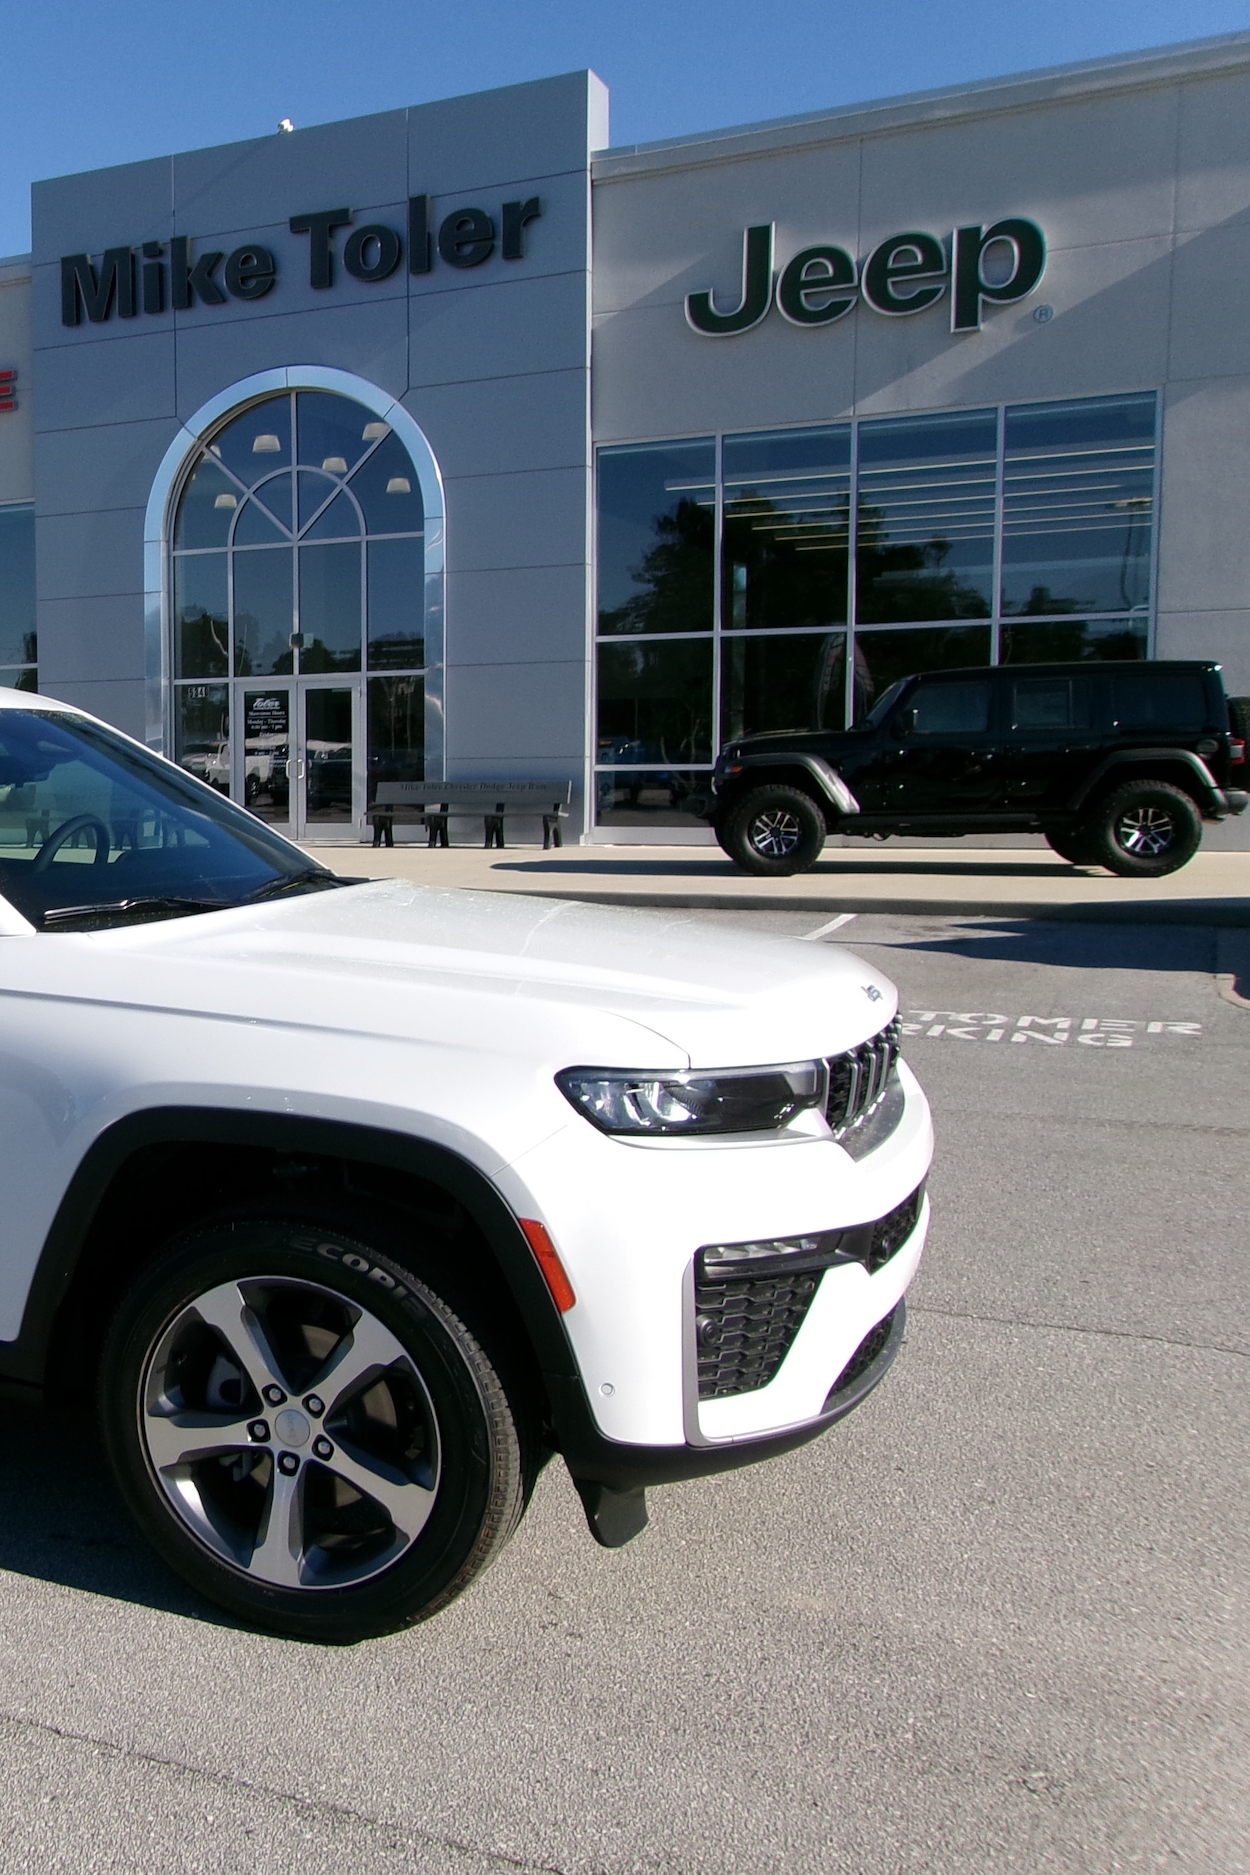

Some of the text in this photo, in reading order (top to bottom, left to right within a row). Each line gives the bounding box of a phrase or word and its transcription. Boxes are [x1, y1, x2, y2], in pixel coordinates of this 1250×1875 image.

[60, 193, 542, 327] Mike Toler
[684, 215, 1049, 338] Jeep
[900, 1023, 1134, 1047] RKING
[908, 1009, 1202, 1035] TOMER
